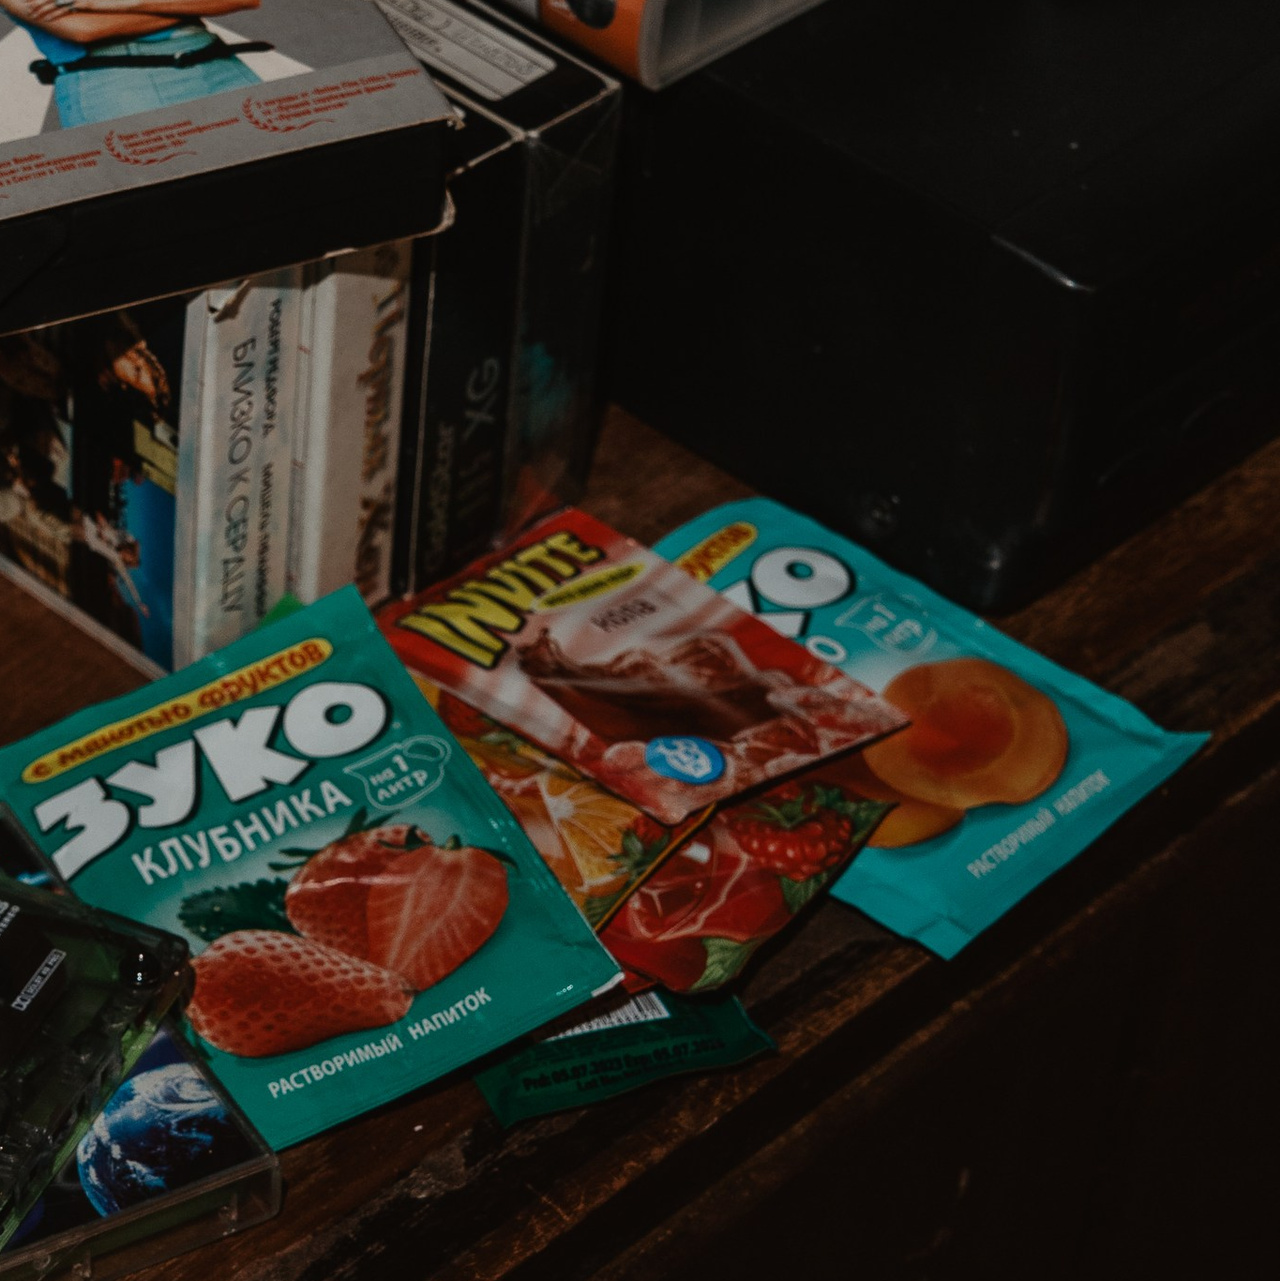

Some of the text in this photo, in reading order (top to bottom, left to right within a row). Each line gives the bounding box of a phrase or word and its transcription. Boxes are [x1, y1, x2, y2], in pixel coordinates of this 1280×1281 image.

[228, 336, 258, 467] БЛИЗКО
[219, 496, 251, 615] СЕРДЦУ
[396, 529, 604, 669] INVITE
[32, 761, 51, 780] с
[198, 642, 326, 711] фруктов
[32, 680, 394, 884] ЗУКО
[130, 779, 354, 887] КЛУБНИКА
[267, 1031, 404, 1100] РАСТВОРИМЫЙ
[407, 986, 493, 1041] НАПИТОК
